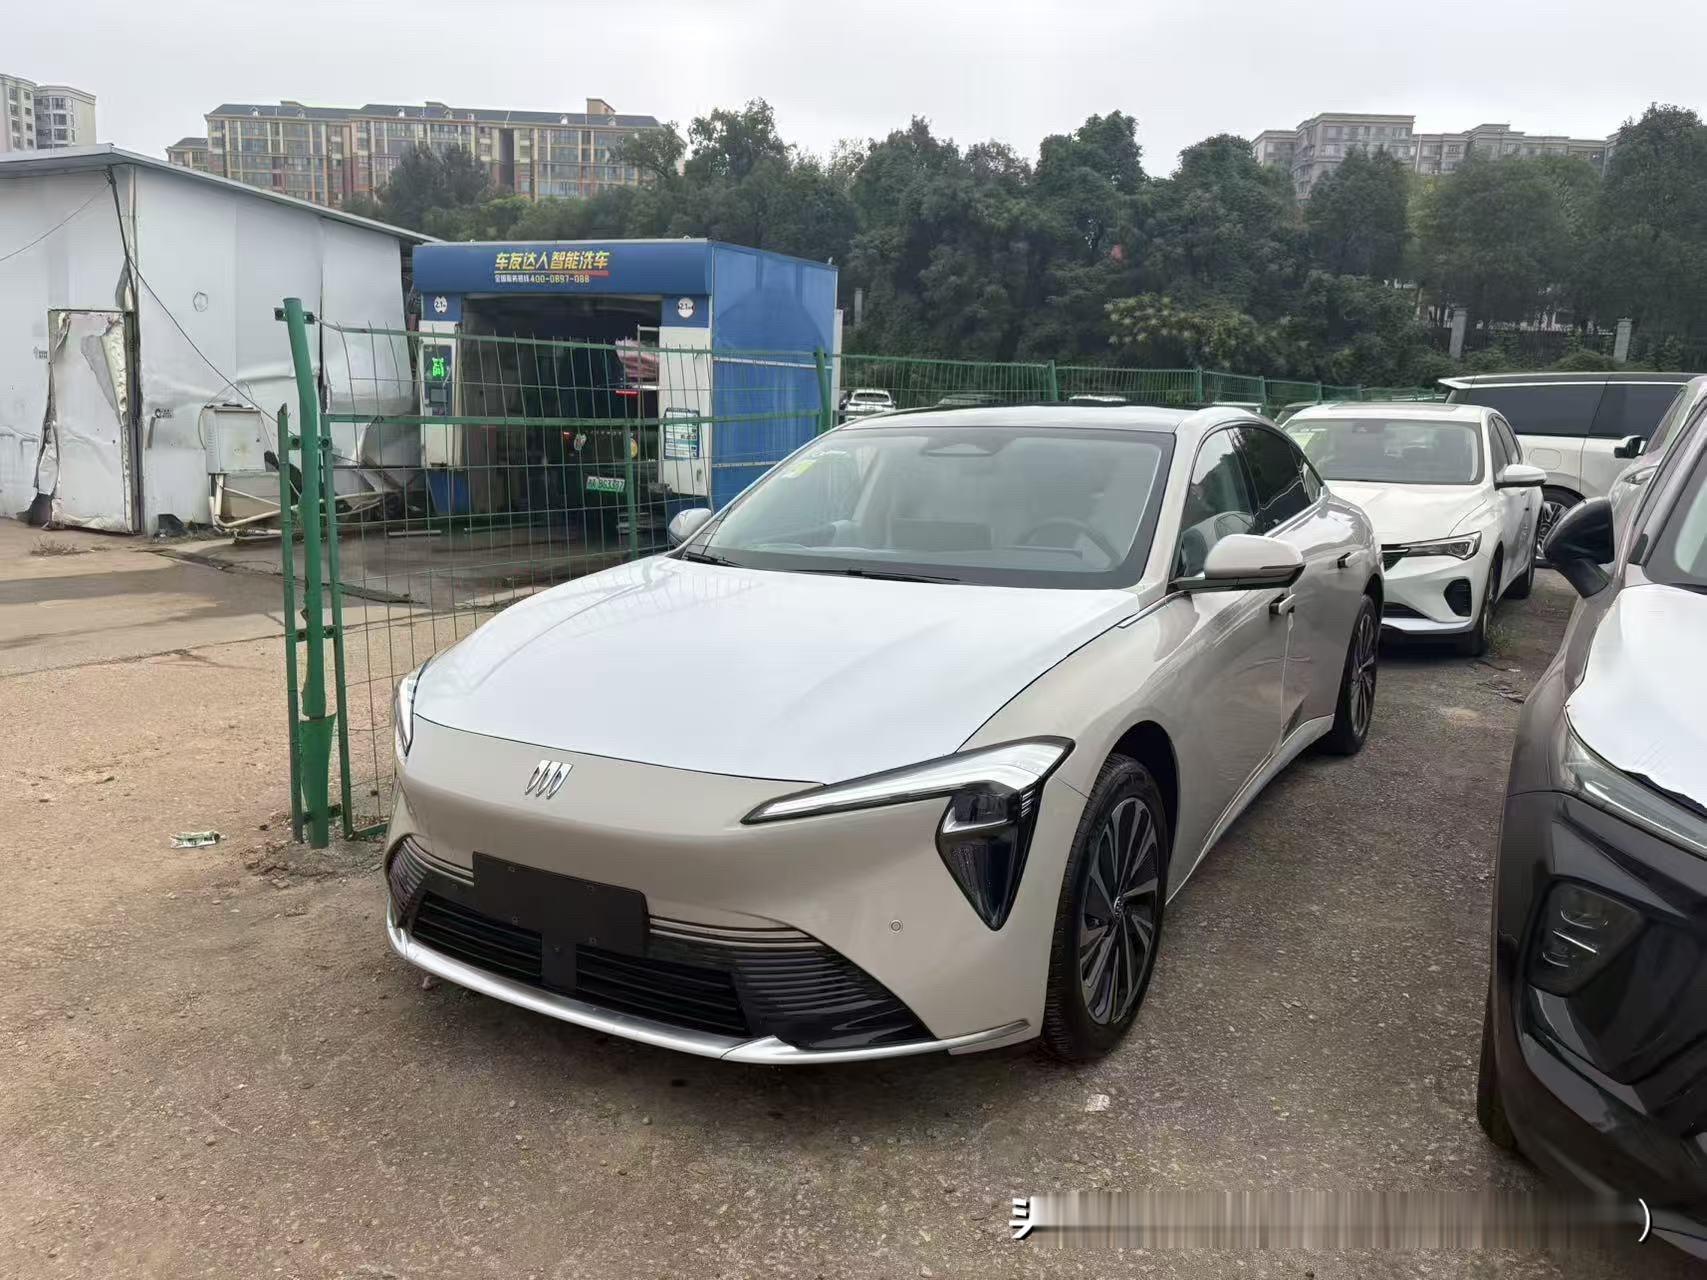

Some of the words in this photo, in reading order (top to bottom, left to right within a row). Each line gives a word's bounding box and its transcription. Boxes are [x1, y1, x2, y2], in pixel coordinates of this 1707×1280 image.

[495, 251, 610, 270] 车友达人智能洗车
